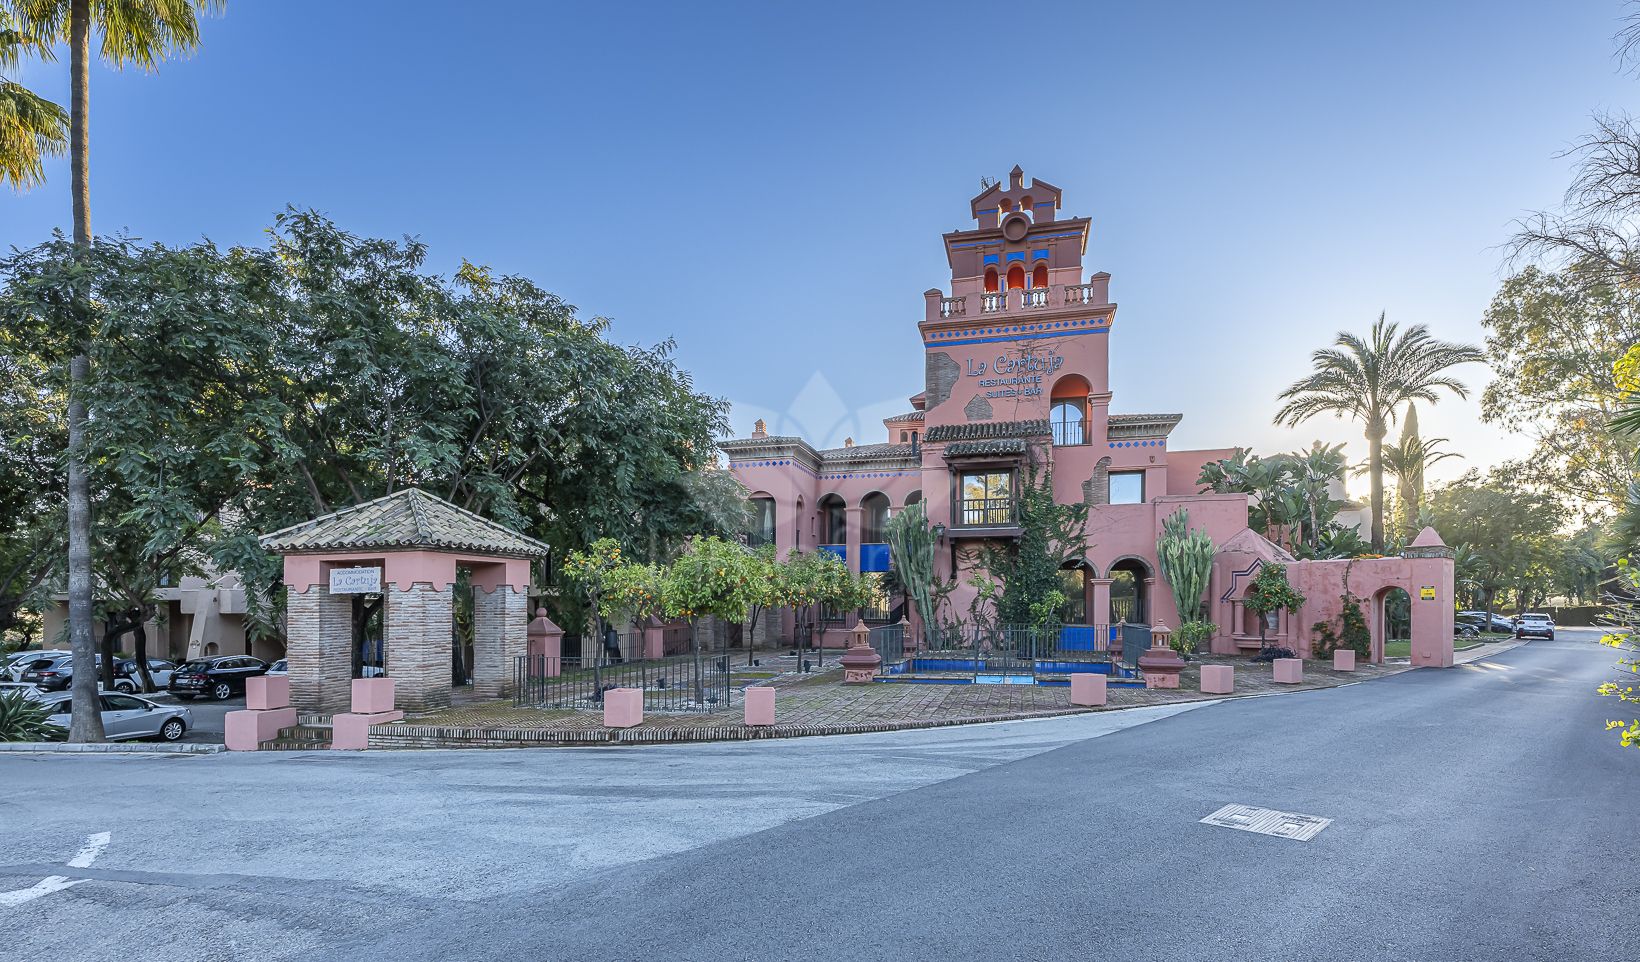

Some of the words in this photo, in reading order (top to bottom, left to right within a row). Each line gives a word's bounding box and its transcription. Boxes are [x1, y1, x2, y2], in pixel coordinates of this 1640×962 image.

[966, 358, 987, 377] La
[993, 350, 1064, 375] Cartuja
[978, 375, 1042, 388] RESTAURANTE
[986, 389, 1017, 398] SUITES
[1024, 387, 1043, 397] BAR
[333, 577, 343, 586] La
[345, 574, 378, 586] Cartuja
